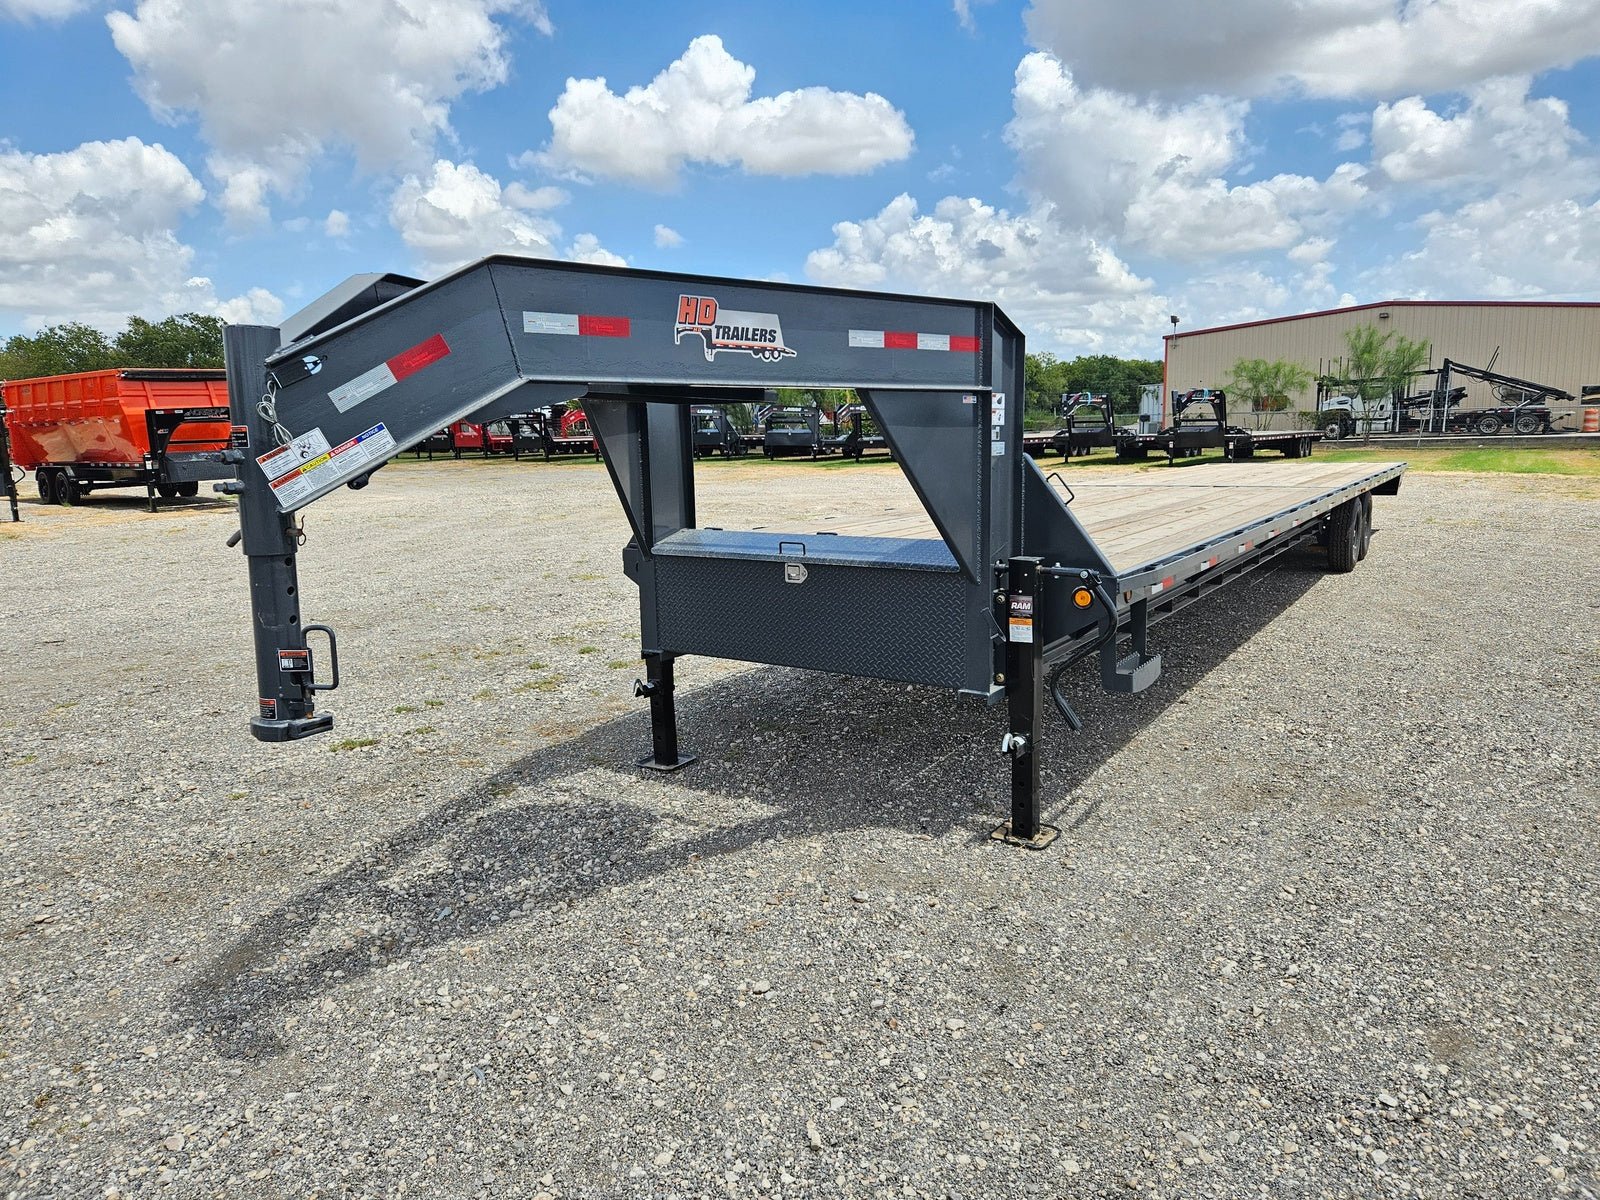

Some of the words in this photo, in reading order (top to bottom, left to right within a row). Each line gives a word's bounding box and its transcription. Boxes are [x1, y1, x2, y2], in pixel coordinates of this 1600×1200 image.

[678, 296, 718, 326] HD
[714, 324, 777, 343] TRAILERS
[361, 427, 378, 439] NOTICE
[334, 441, 355, 454] DANGER
[305, 455, 327, 469] CAUTION
[1011, 602, 1031, 610] RAM
